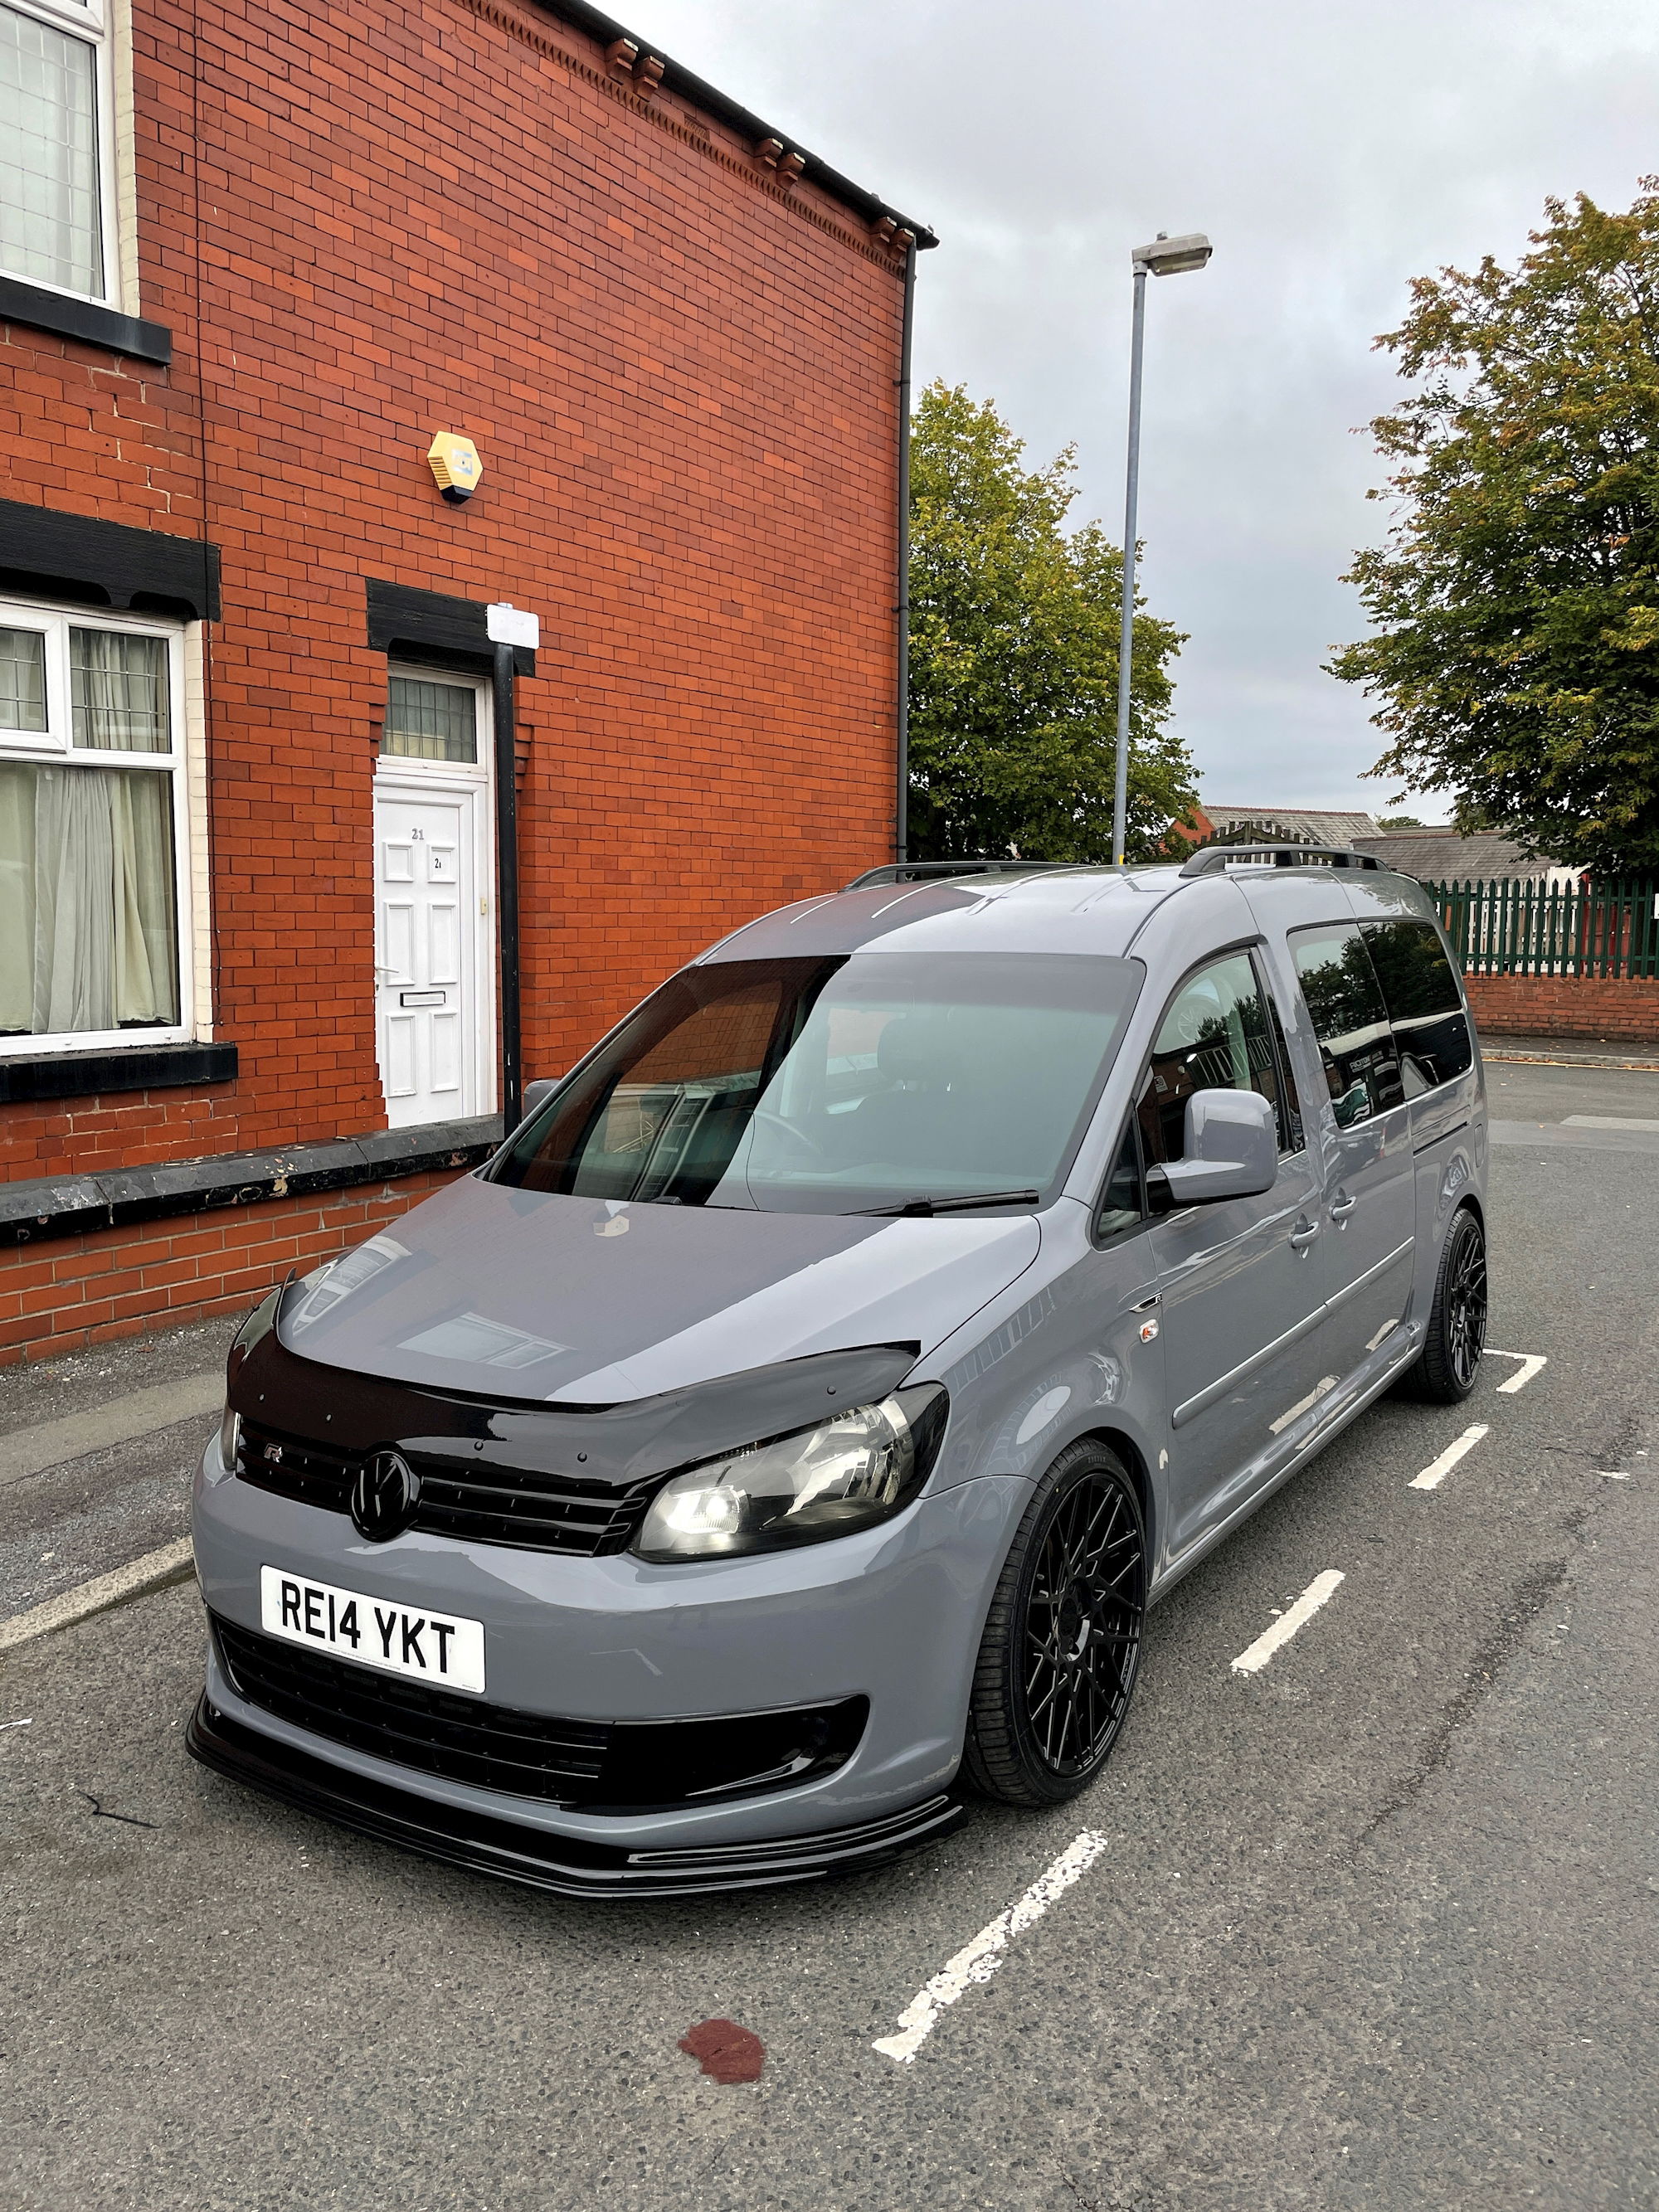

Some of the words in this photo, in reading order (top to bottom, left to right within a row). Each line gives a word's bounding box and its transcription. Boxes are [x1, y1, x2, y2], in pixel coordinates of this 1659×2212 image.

[411, 828, 425, 840] 21
[435, 858, 441, 869] 21
[264, 1442, 283, 1463] R
[281, 1579, 361, 1649] RE14
[373, 1607, 455, 1674] YKT
